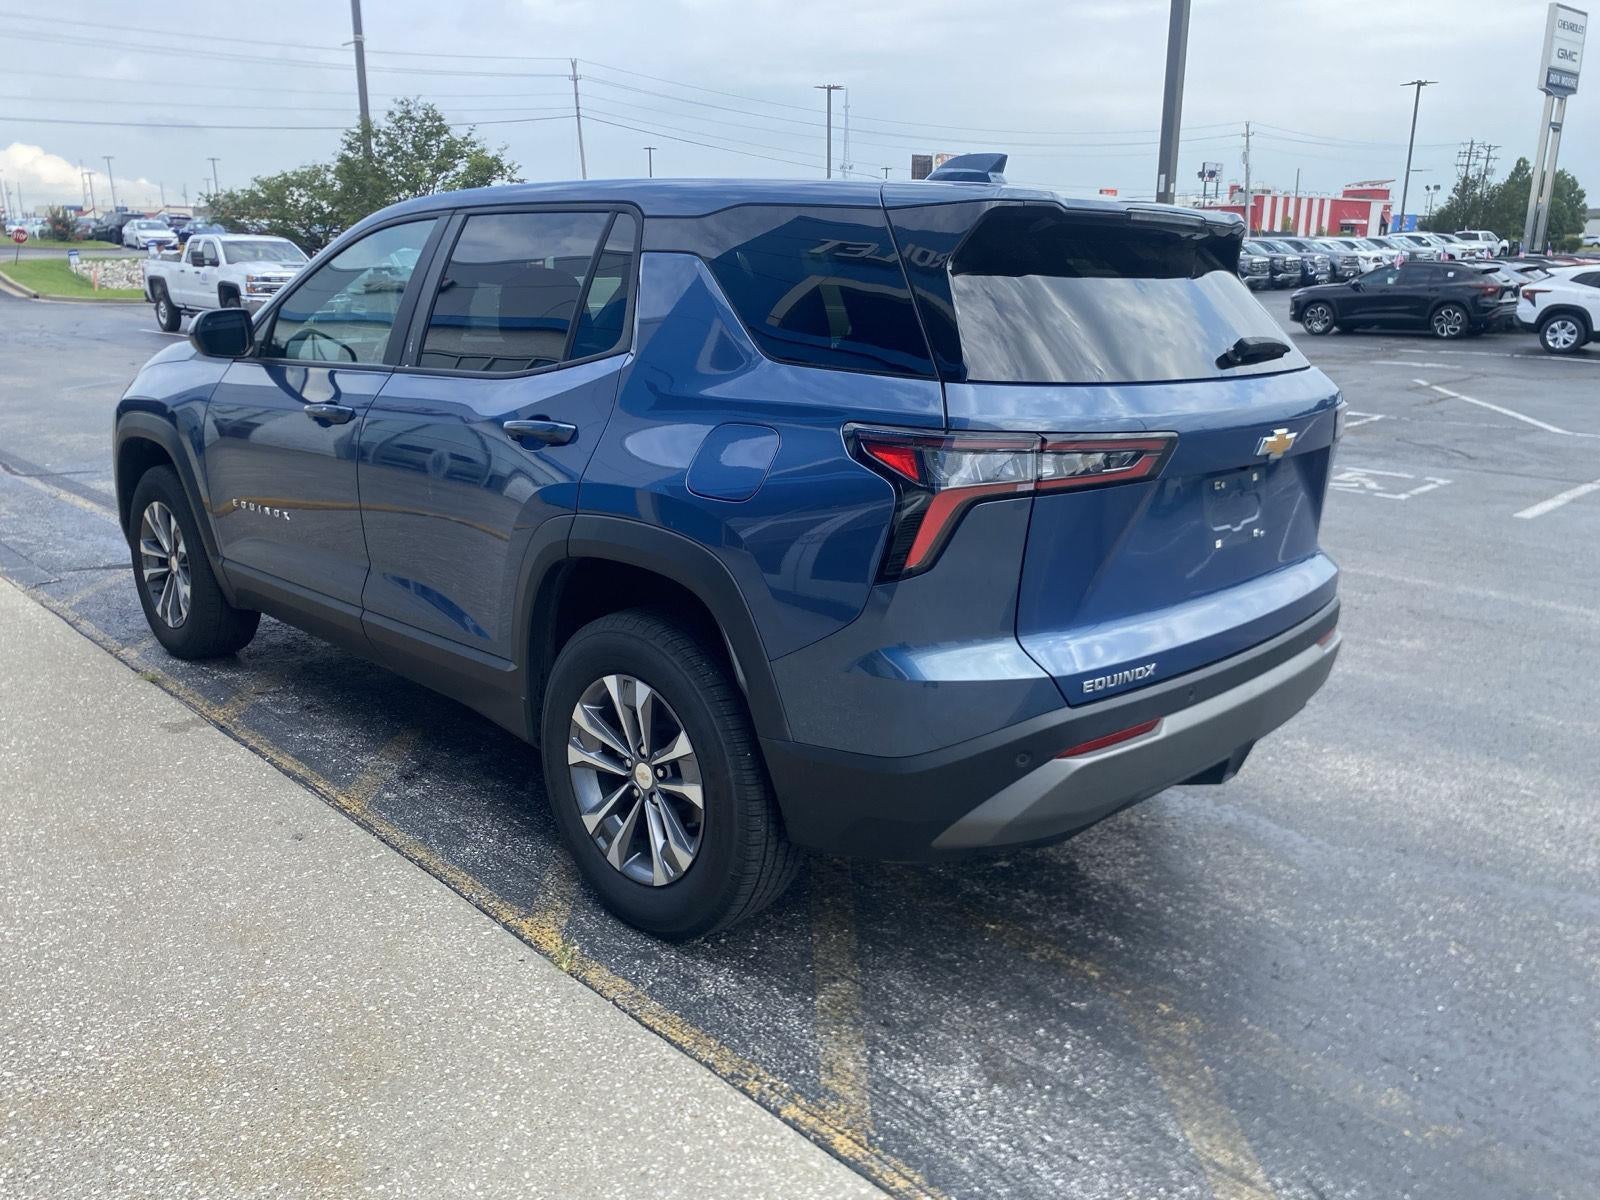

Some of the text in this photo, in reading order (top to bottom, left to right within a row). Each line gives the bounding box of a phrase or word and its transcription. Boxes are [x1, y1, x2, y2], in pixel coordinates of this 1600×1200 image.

[1557, 19, 1584, 34] CHEVROLET
[1557, 48, 1578, 62] GMC
[14, 231, 27, 241] STOP
[232, 498, 291, 521] EQUINOX
[1082, 662, 1157, 694] EQUINOX
